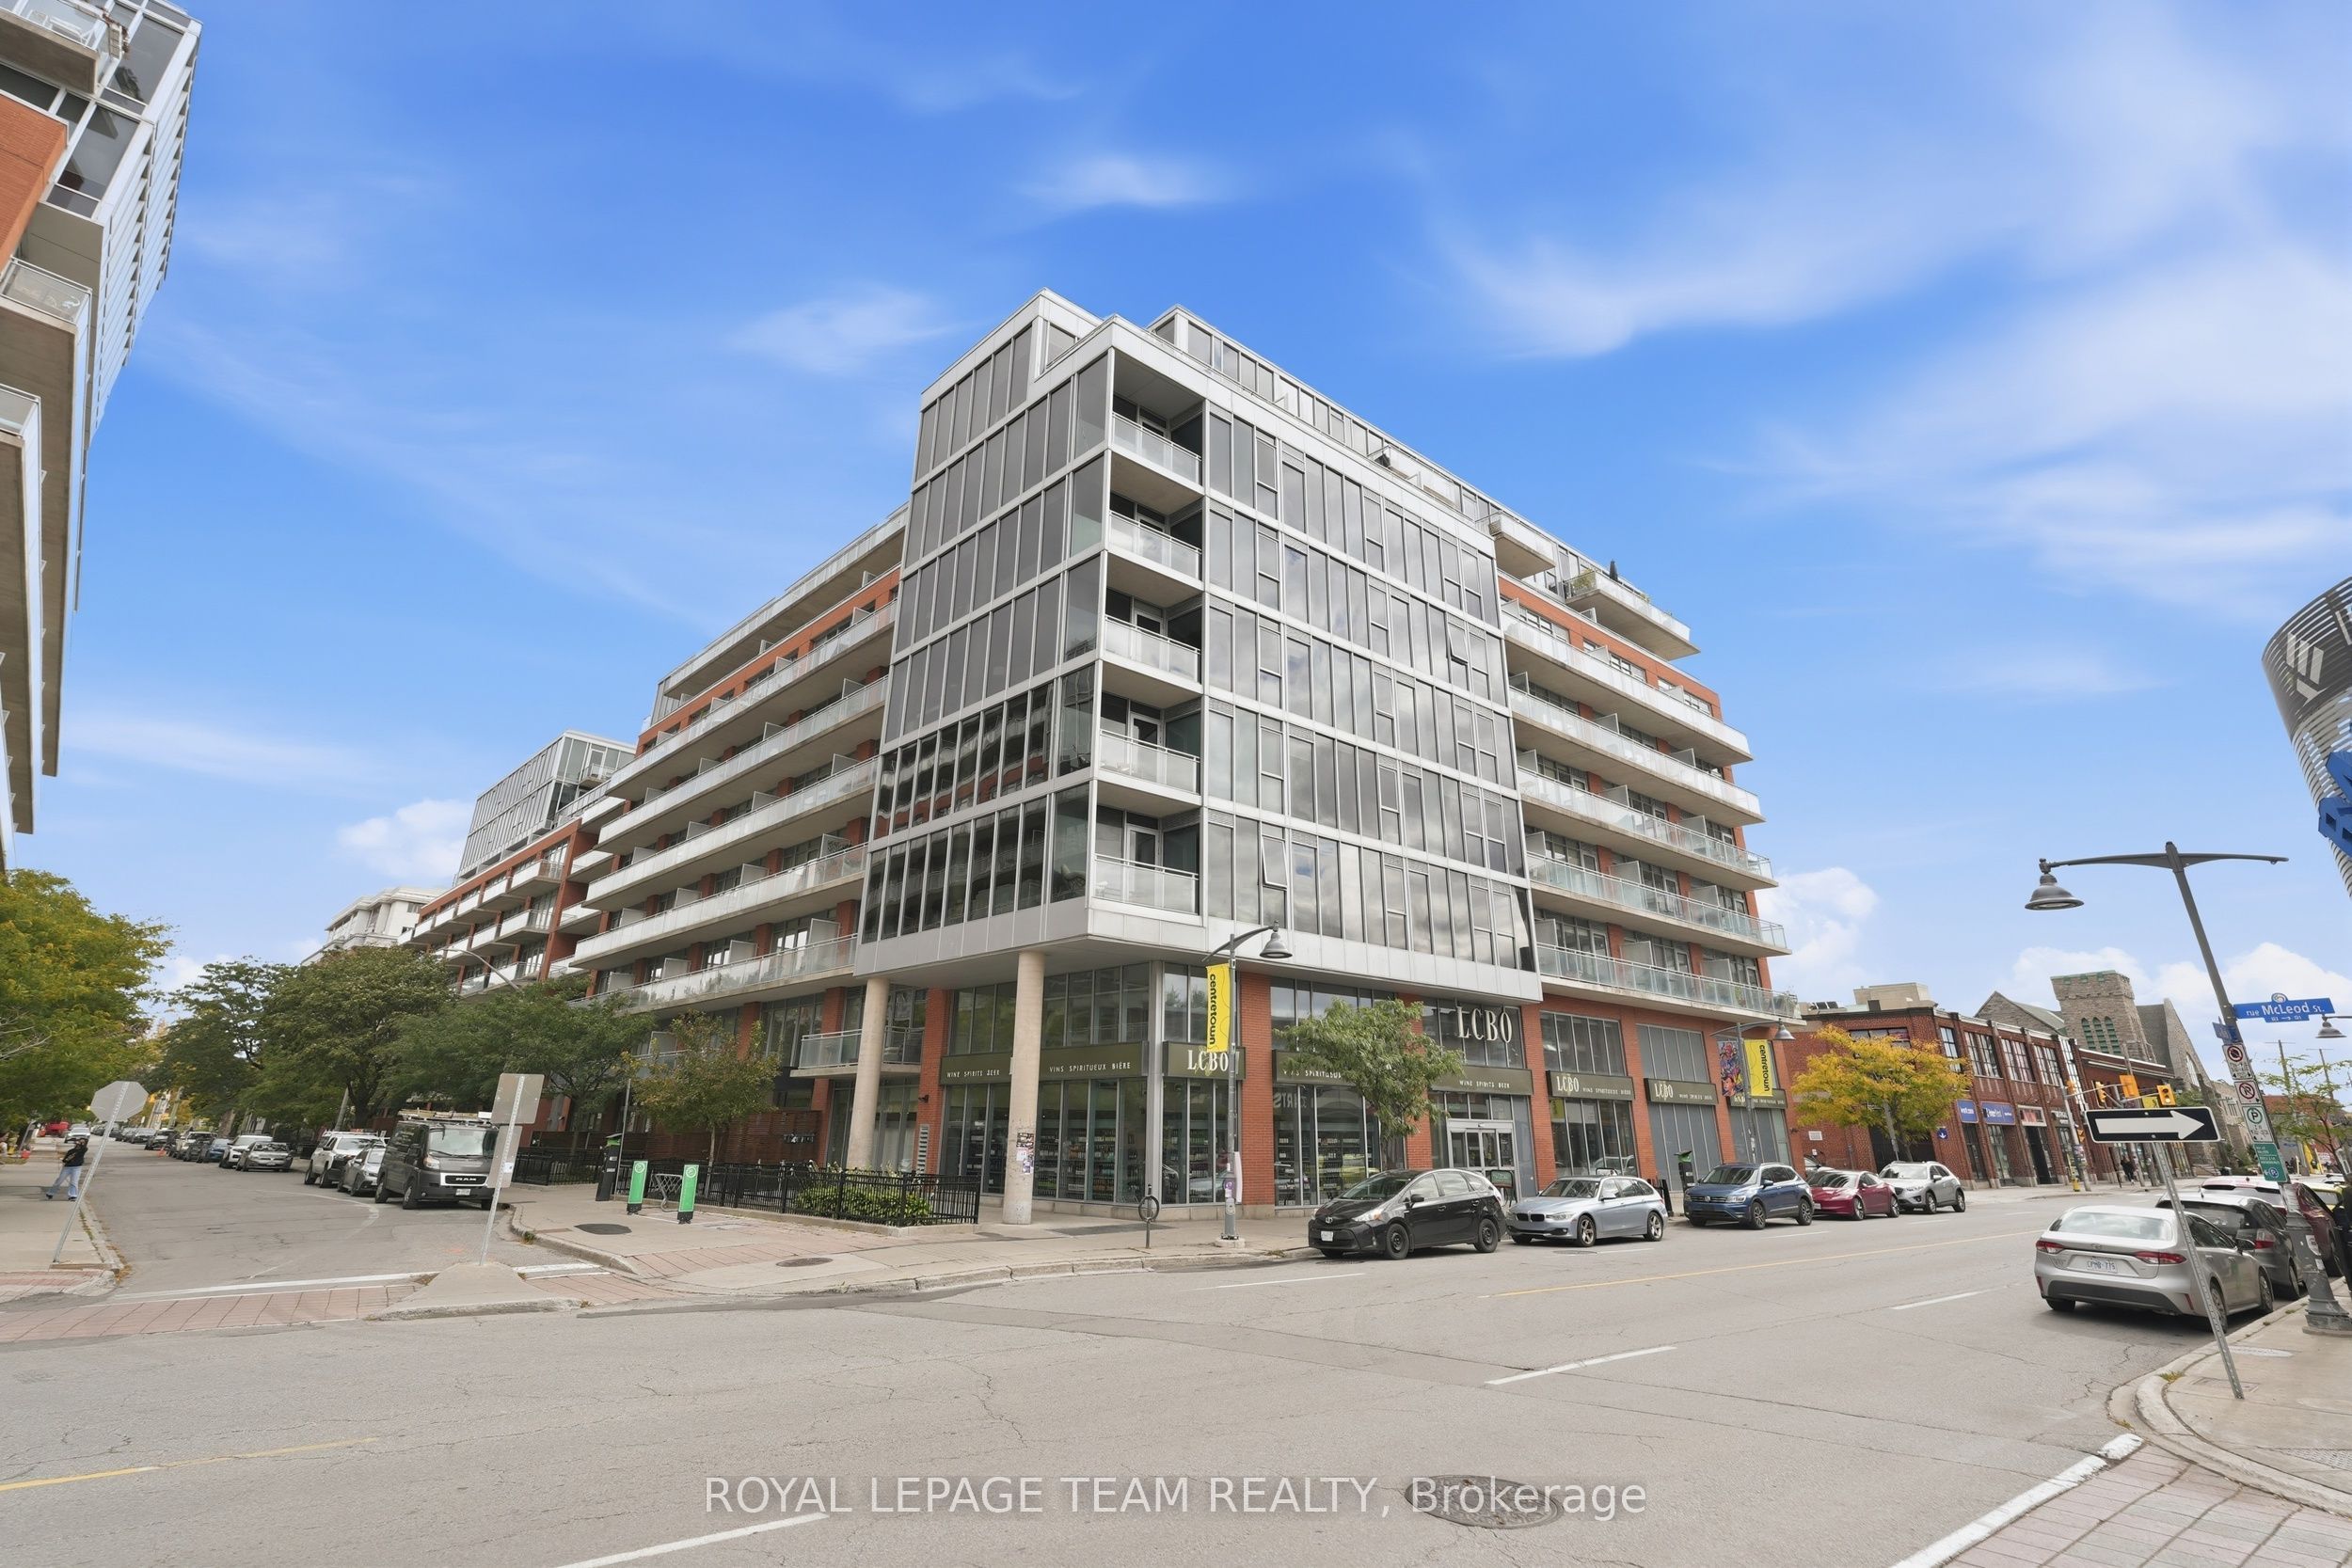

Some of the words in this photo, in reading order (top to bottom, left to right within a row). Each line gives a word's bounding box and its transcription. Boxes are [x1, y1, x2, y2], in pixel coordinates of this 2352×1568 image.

[2261, 1002, 2310, 1015] McLeod
[1457, 1006, 1512, 1043] LCBO
[1069, 1064, 1106, 1072] SPIRITUEUX
[1187, 1050, 1229, 1071] LCBO
[1759, 1044, 1770, 1092] centretown
[1556, 1075, 1580, 1092] LCBO
[1654, 1083, 1674, 1099] LCBO
